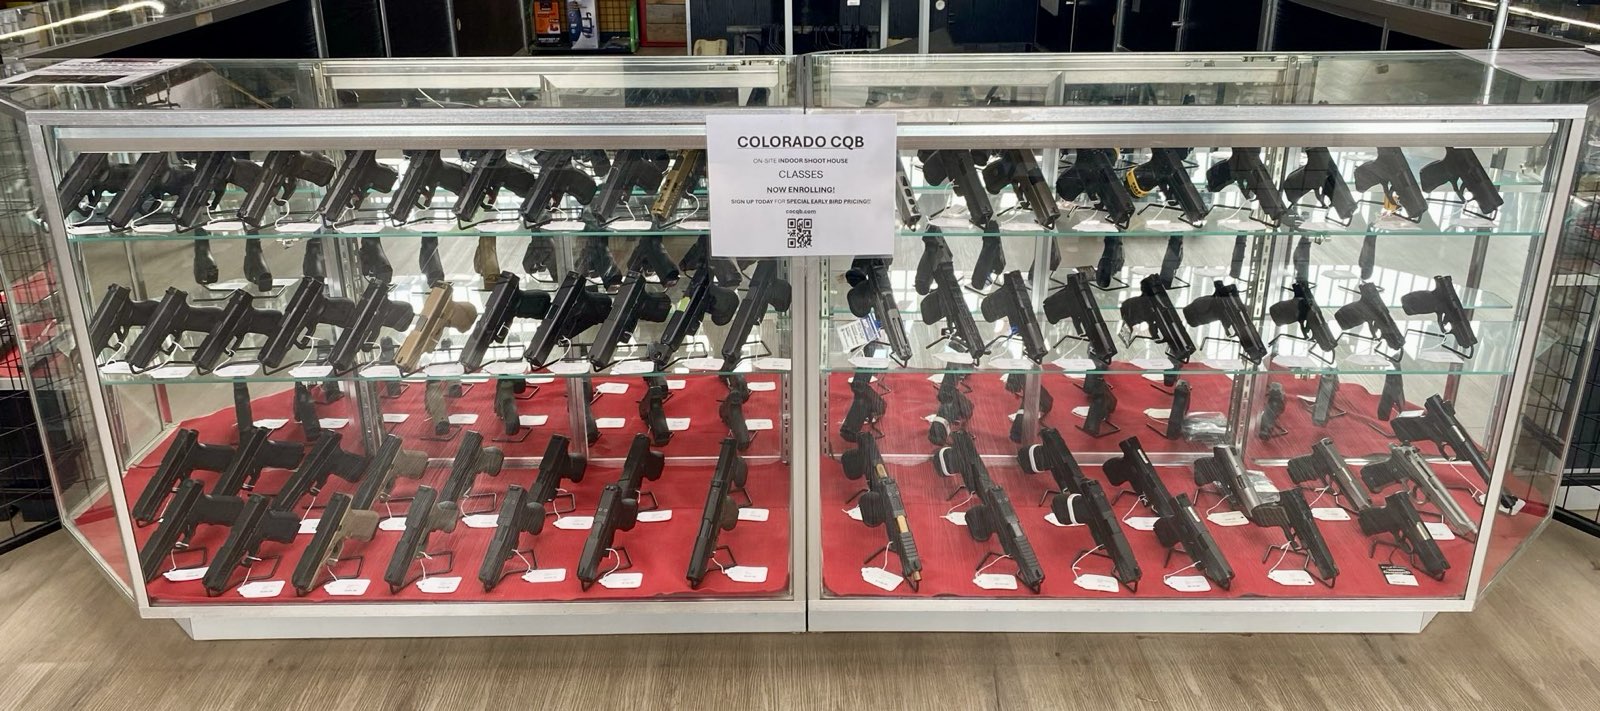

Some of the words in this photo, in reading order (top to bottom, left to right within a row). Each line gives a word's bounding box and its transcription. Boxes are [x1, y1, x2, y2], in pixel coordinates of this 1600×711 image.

[737, 136, 826, 148] COLORADO
[831, 136, 865, 150] CQB
[778, 170, 824, 179] CLASSES
[766, 186, 787, 194] NOW
[788, 186, 836, 194] ENROLLING!
